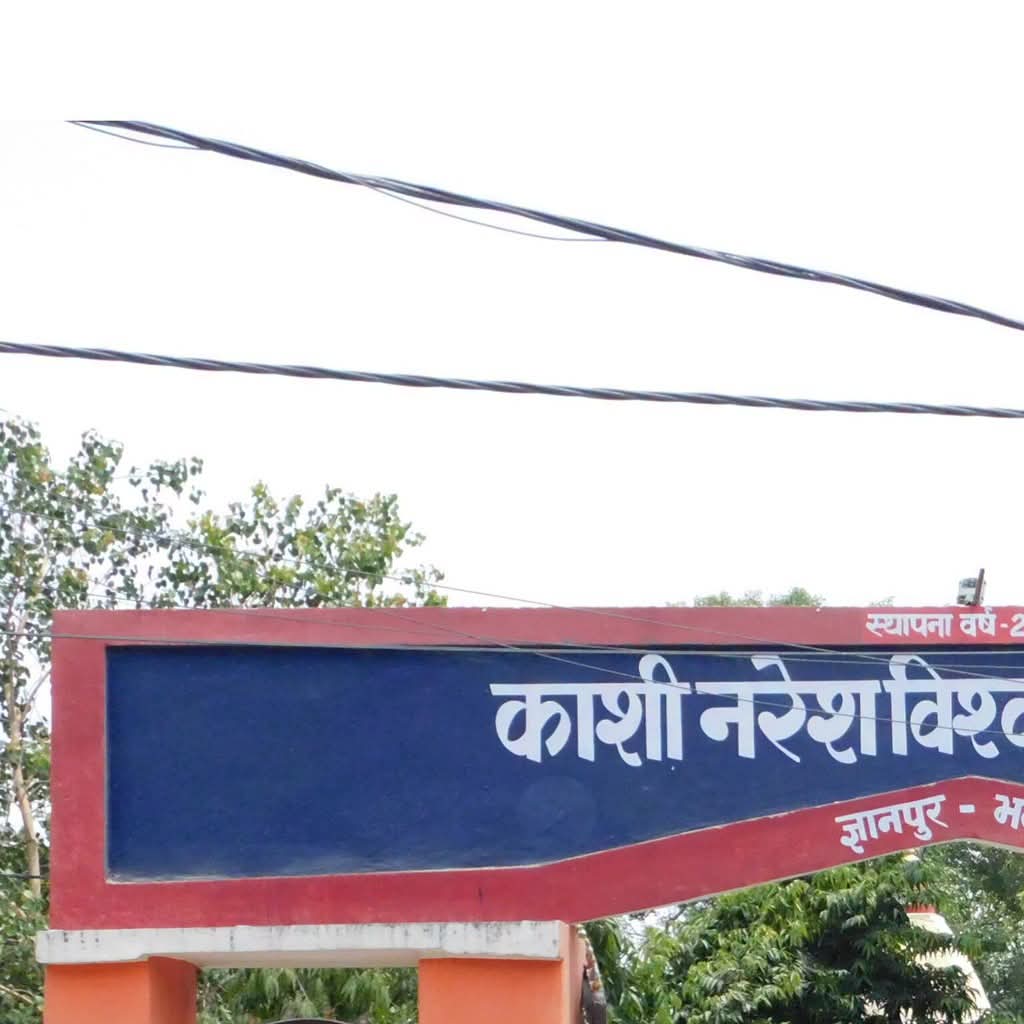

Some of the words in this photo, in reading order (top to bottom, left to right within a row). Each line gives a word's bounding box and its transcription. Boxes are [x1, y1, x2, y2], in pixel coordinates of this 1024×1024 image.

[865, 613, 954, 638] स्थापना
[489, 653, 694, 767] काशी
[695, 655, 882, 764] नरेश
[834, 794, 949, 854] ज्ञानपुर
